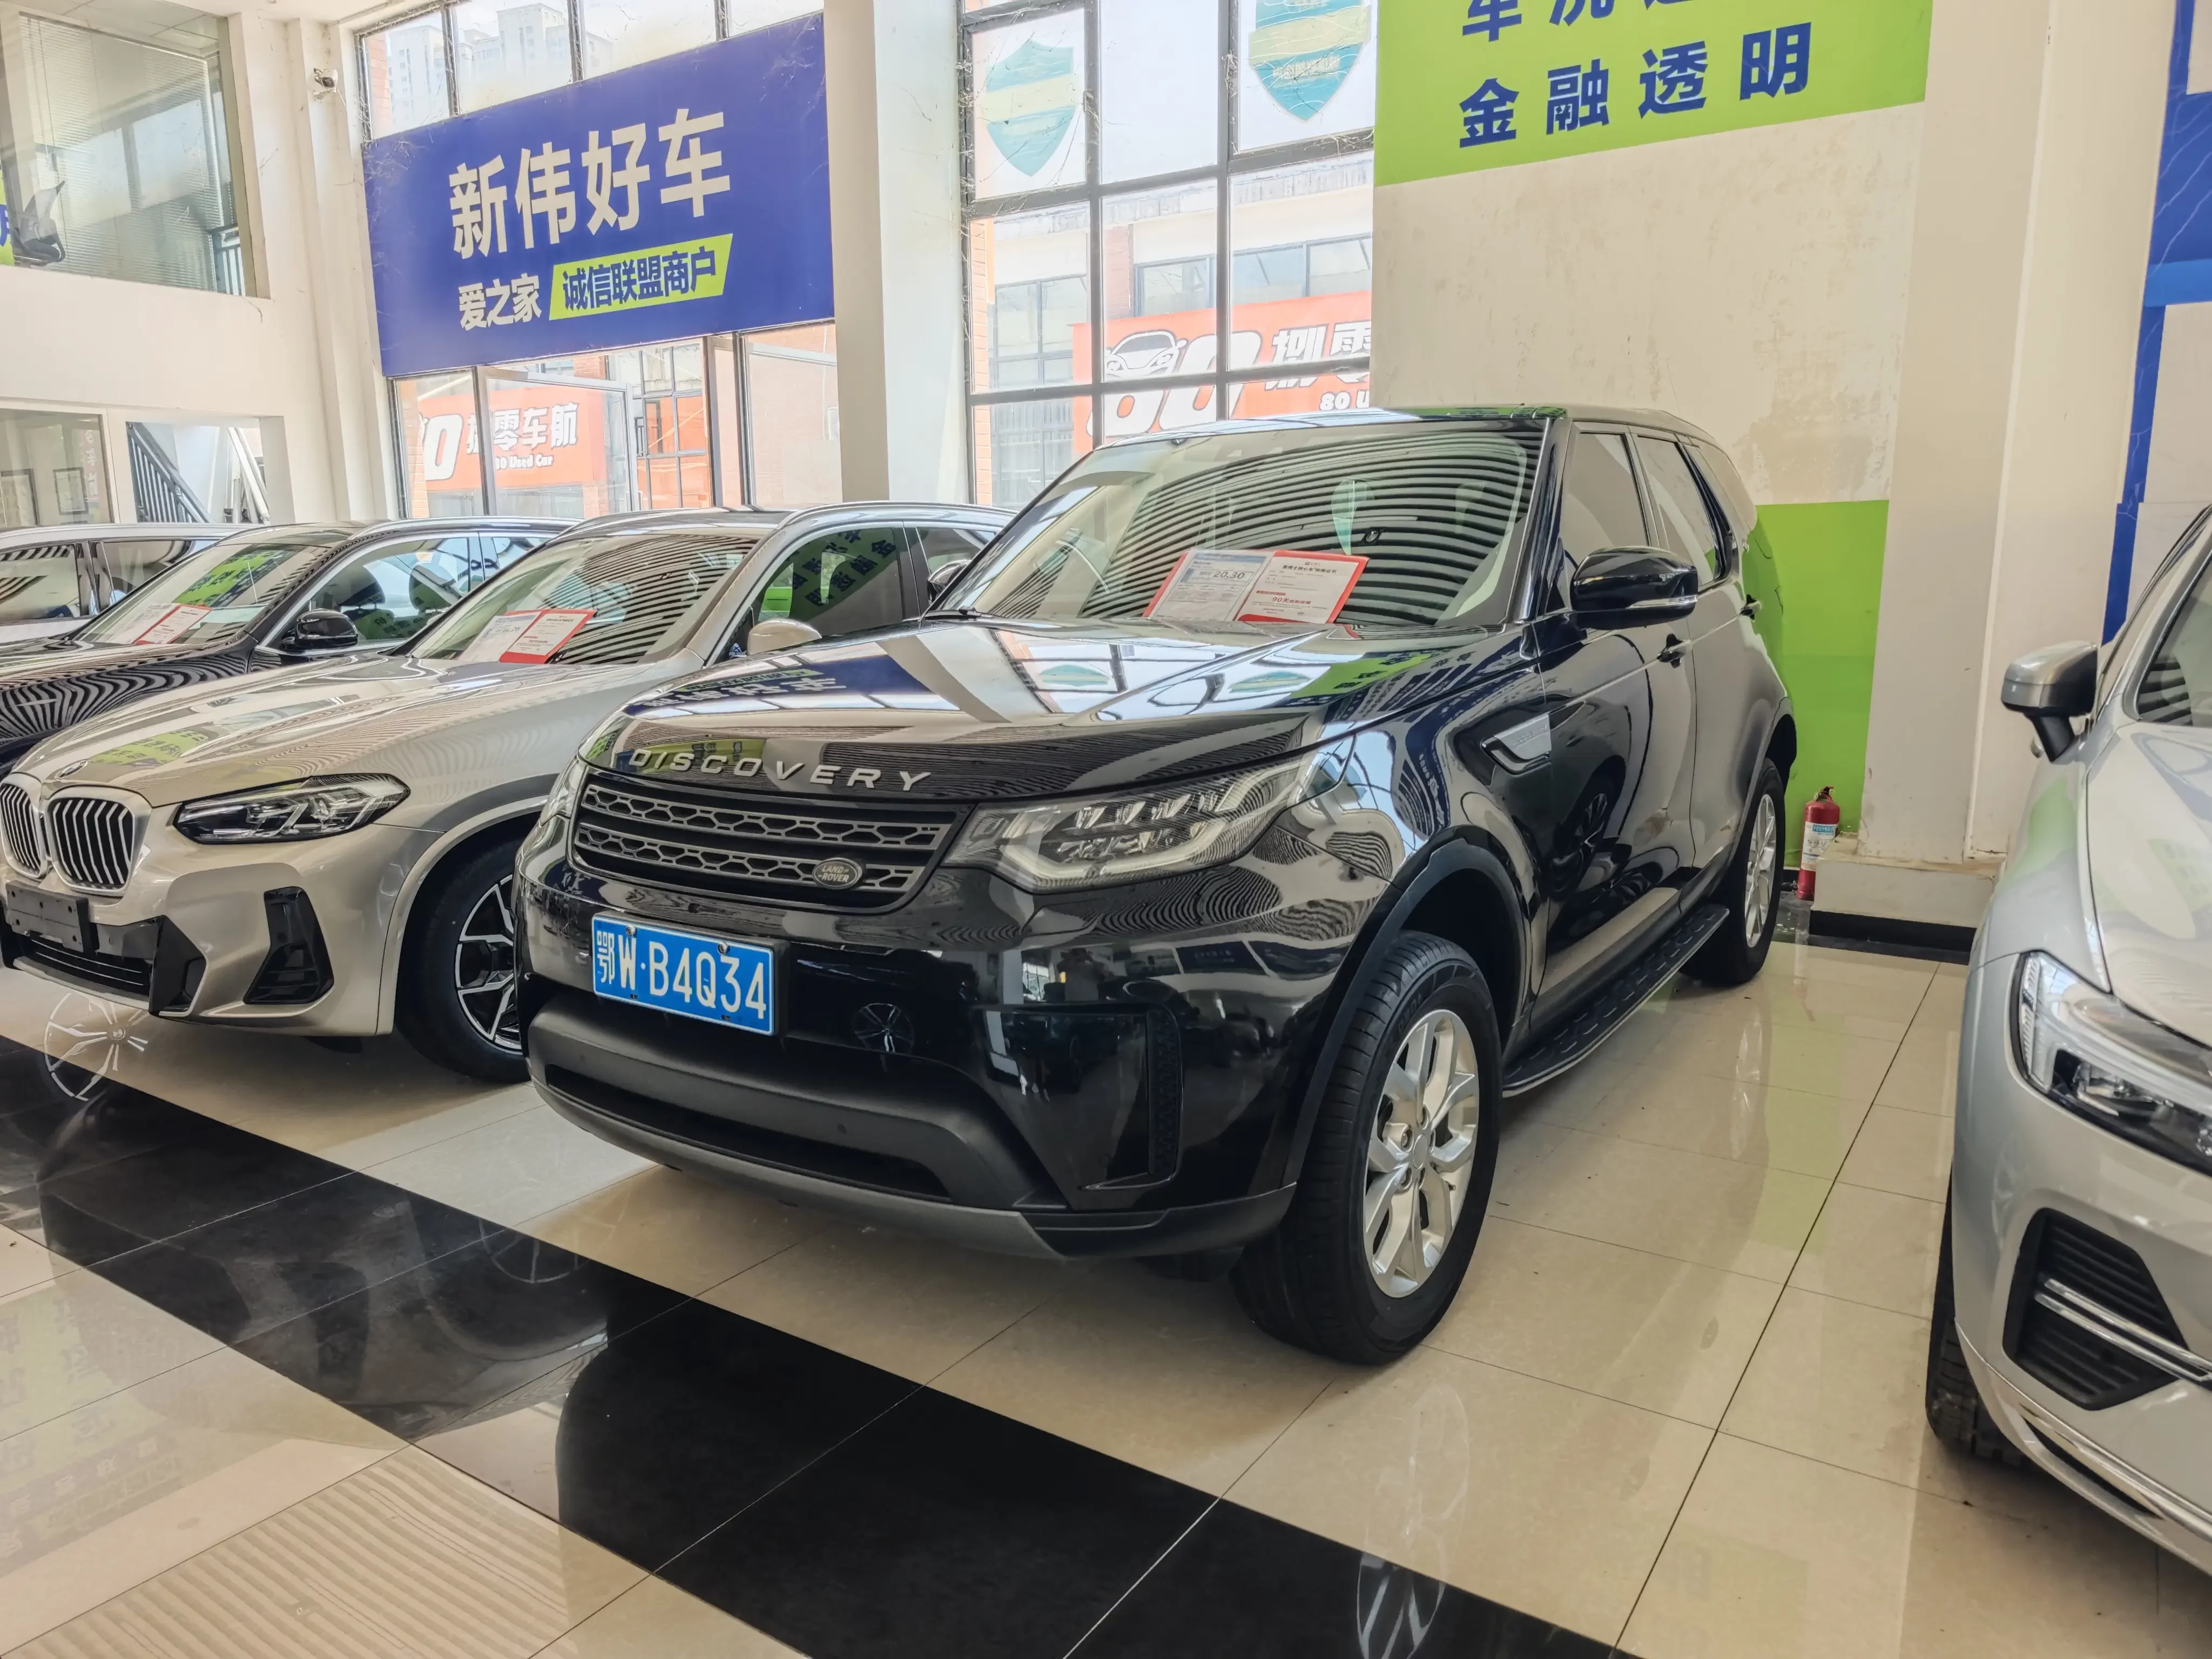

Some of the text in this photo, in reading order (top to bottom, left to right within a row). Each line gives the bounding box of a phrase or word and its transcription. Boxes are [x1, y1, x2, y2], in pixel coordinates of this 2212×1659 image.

[1459, 22, 1812, 148] 金融透明
[449, 108, 731, 259] 新伟好车
[458, 246, 716, 331] 爱之家 诚信联盟商户
[1320, 391, 1351, 411] 80
[509, 453, 534, 469] Used
[535, 453, 554, 468] Car
[1212, 571, 1245, 579] 20.30
[629, 748, 931, 791] DISCOVERY
[821, 865, 845, 873] LAND
[821, 873, 849, 882] ROVER
